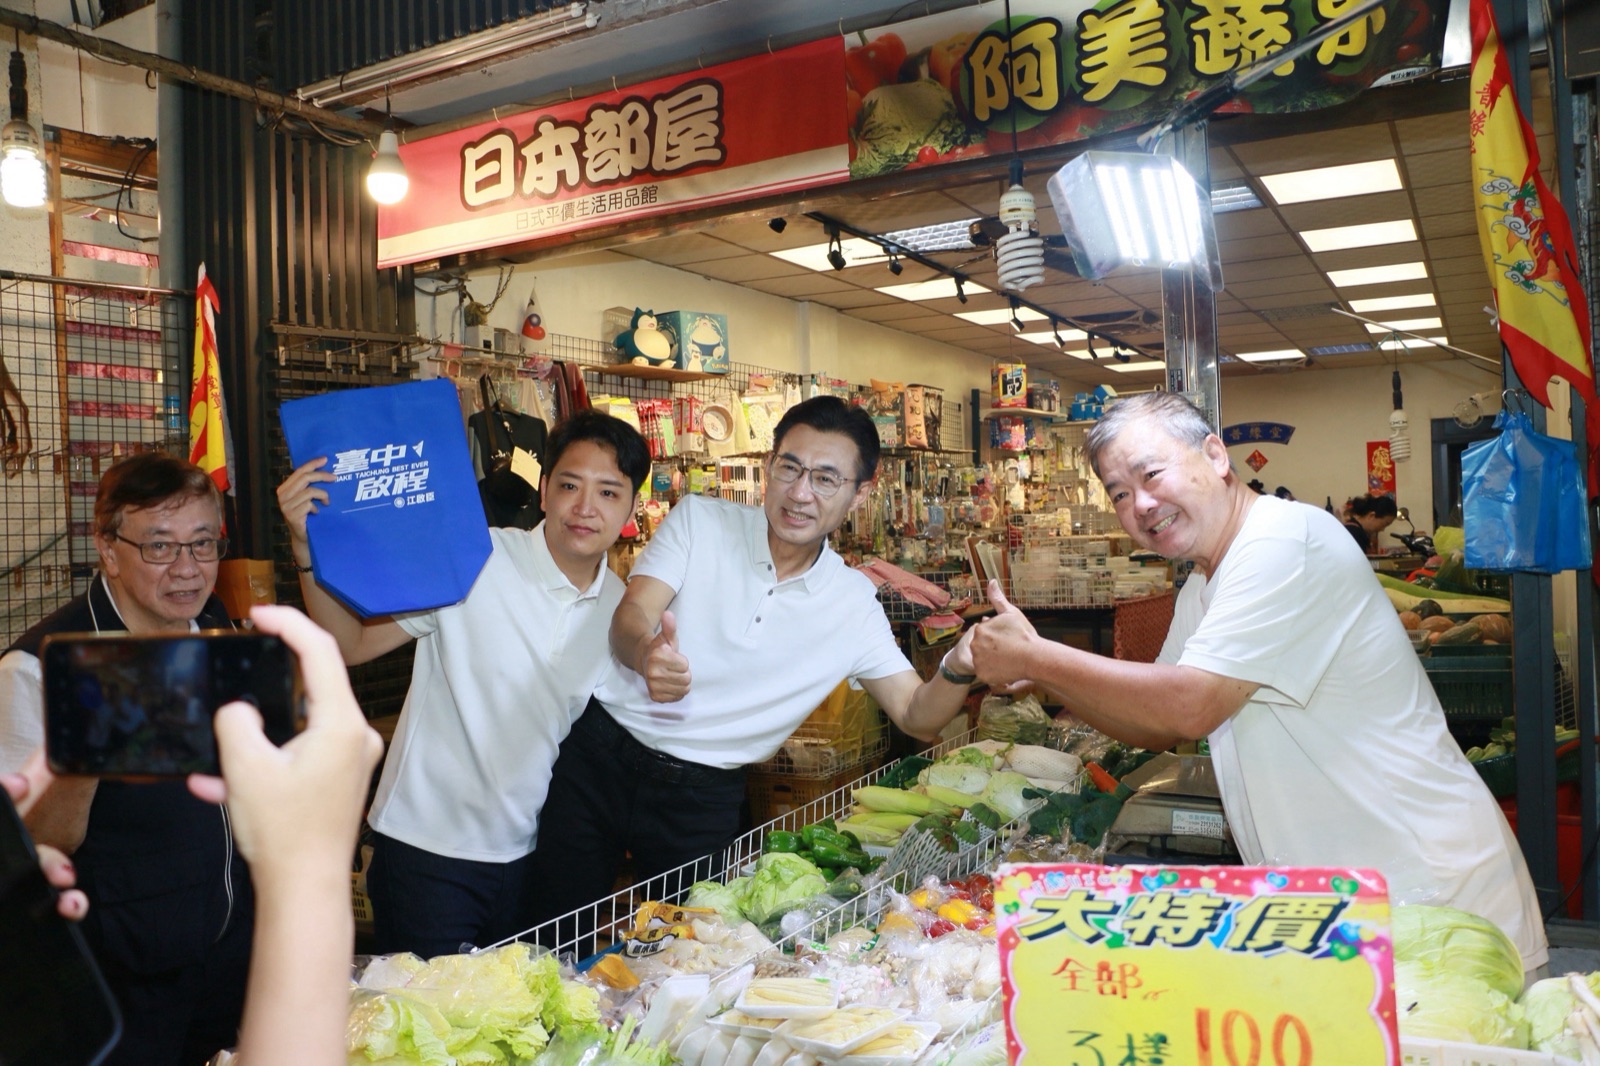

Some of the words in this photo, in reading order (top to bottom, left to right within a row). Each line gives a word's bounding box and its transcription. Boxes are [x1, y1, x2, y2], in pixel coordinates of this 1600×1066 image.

[461, 80, 725, 210] 日本部屋
[515, 184, 659, 231] 日式平價生活用品館
[333, 443, 408, 475] 臺中
[355, 468, 390, 480] TAICHUNG
[391, 464, 409, 473] BEST
[411, 460, 429, 469] EVER
[1017, 888, 1346, 954] 大特價
[1051, 957, 1144, 1000] 全部
[1194, 1007, 1314, 1066] 100
